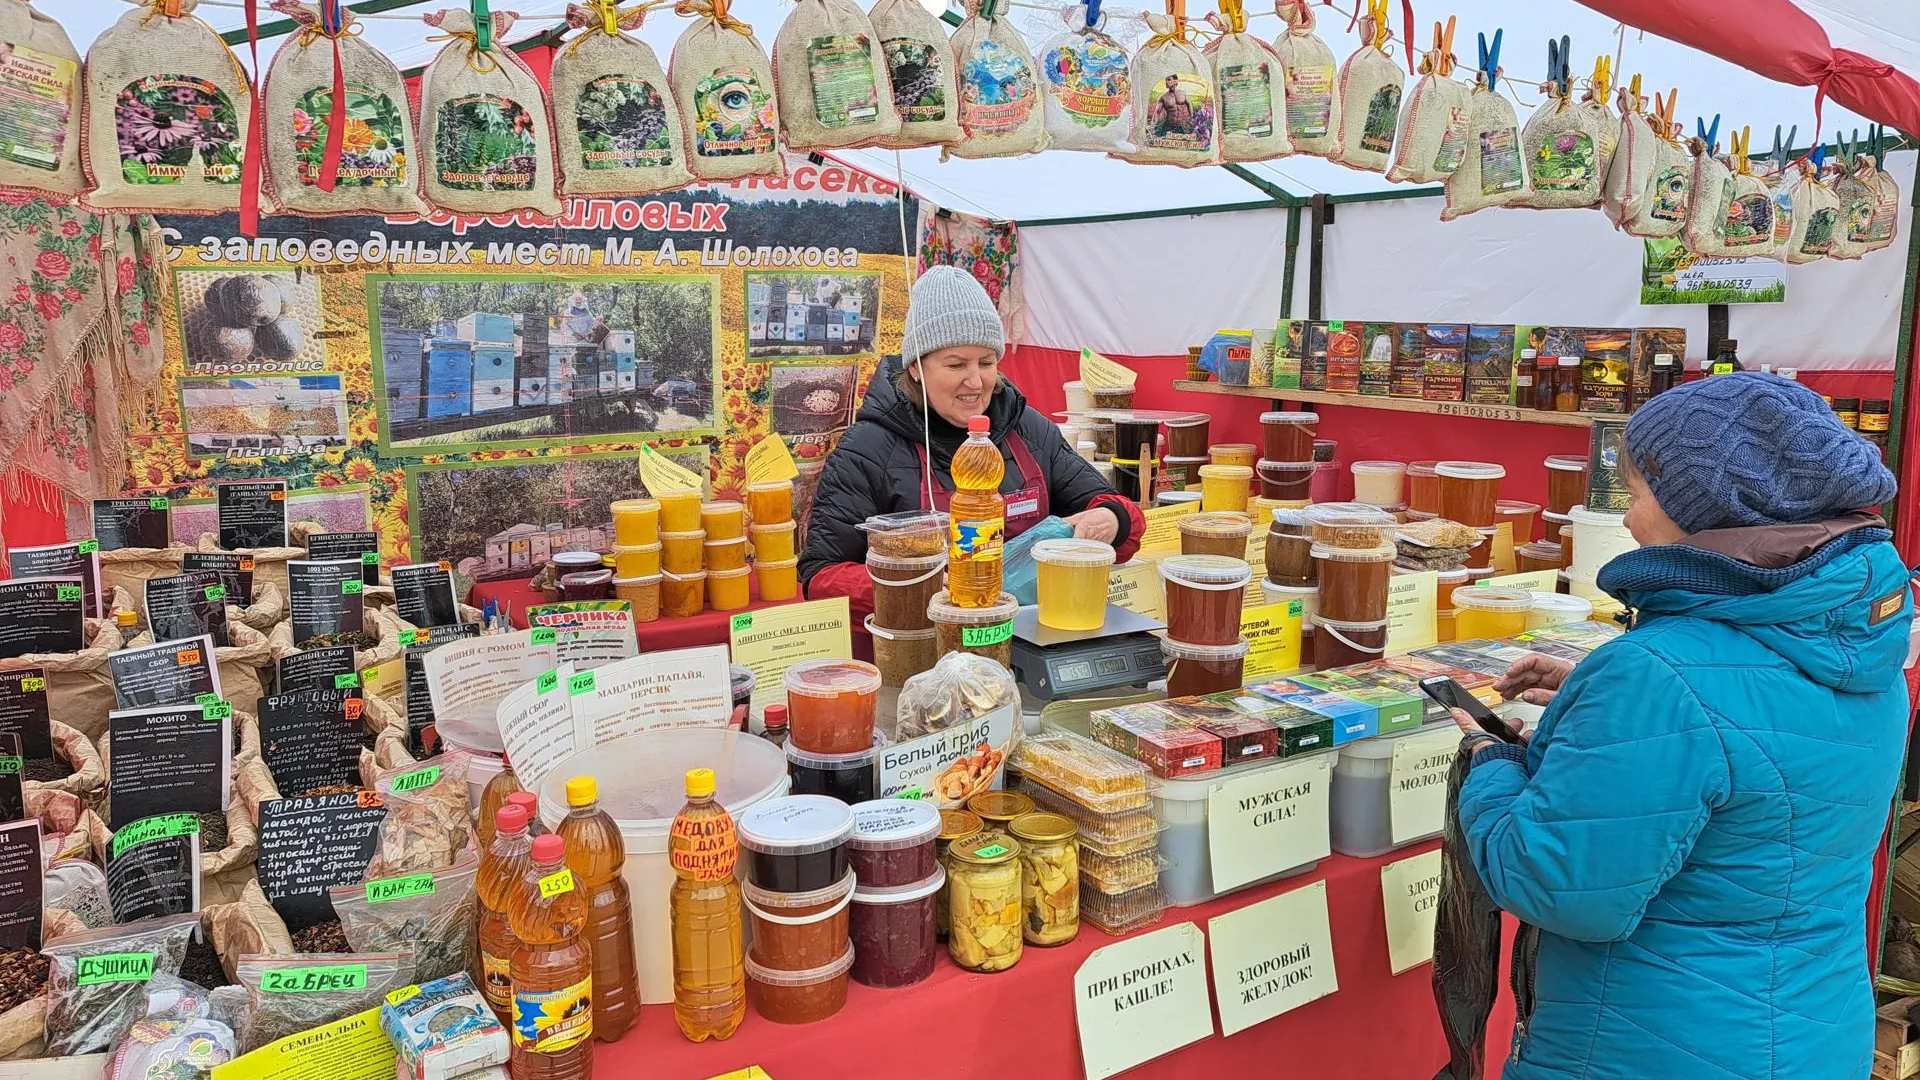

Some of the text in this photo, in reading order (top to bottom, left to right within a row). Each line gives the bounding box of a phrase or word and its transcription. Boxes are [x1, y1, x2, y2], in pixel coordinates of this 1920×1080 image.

[0, 66, 39, 82] УЖСКАЯ
[704, 140, 741, 150] Отличное
[199, 231, 473, 264] заповедных
[487, 239, 591, 266] мест
[604, 237, 641, 266] М.
[654, 238, 687, 267] А.
[700, 238, 859, 267] Шолохова
[194, 358, 323, 374] Прополис
[1437, 404, 1522, 421] 89613080539
[225, 442, 327, 459] Пыльца
[63, 547, 76, 555] ЛЕС
[1109, 581, 1138, 593] ЕДРОВОЙ
[537, 611, 628, 626] ЧЕРНИКА
[156, 642, 199, 657] ТРАВЯНОЙ
[487, 642, 526, 652] РОМОМ
[149, 658, 169, 668] СБОР
[631, 685, 672, 700] ПЕРСИК
[146, 714, 187, 725] МОХИТО
[209, 707, 227, 716] 350
[885, 720, 991, 770] Белый гриб
[899, 762, 931, 780] Сухой
[396, 770, 433, 790] ЛИПА
[1239, 780, 1312, 813] МУЖСКАЯ
[1253, 804, 1296, 828] СИЛА!
[546, 875, 570, 893] 250
[79, 958, 149, 978] ДУШИЦА
[1237, 942, 1311, 985] ЗДОРОВЫЙ
[1087, 950, 1195, 1000] ПРИ БРОНХАХ,
[1241, 964, 1313, 1005] ЖЕЛУДОК!
[409, 988, 470, 1015] БОРОВАЯ МАТКА
[1113, 978, 1175, 1013] КАШЛЕ!
[281, 1019, 367, 1053] СЕМЕНА ЛЬНА
